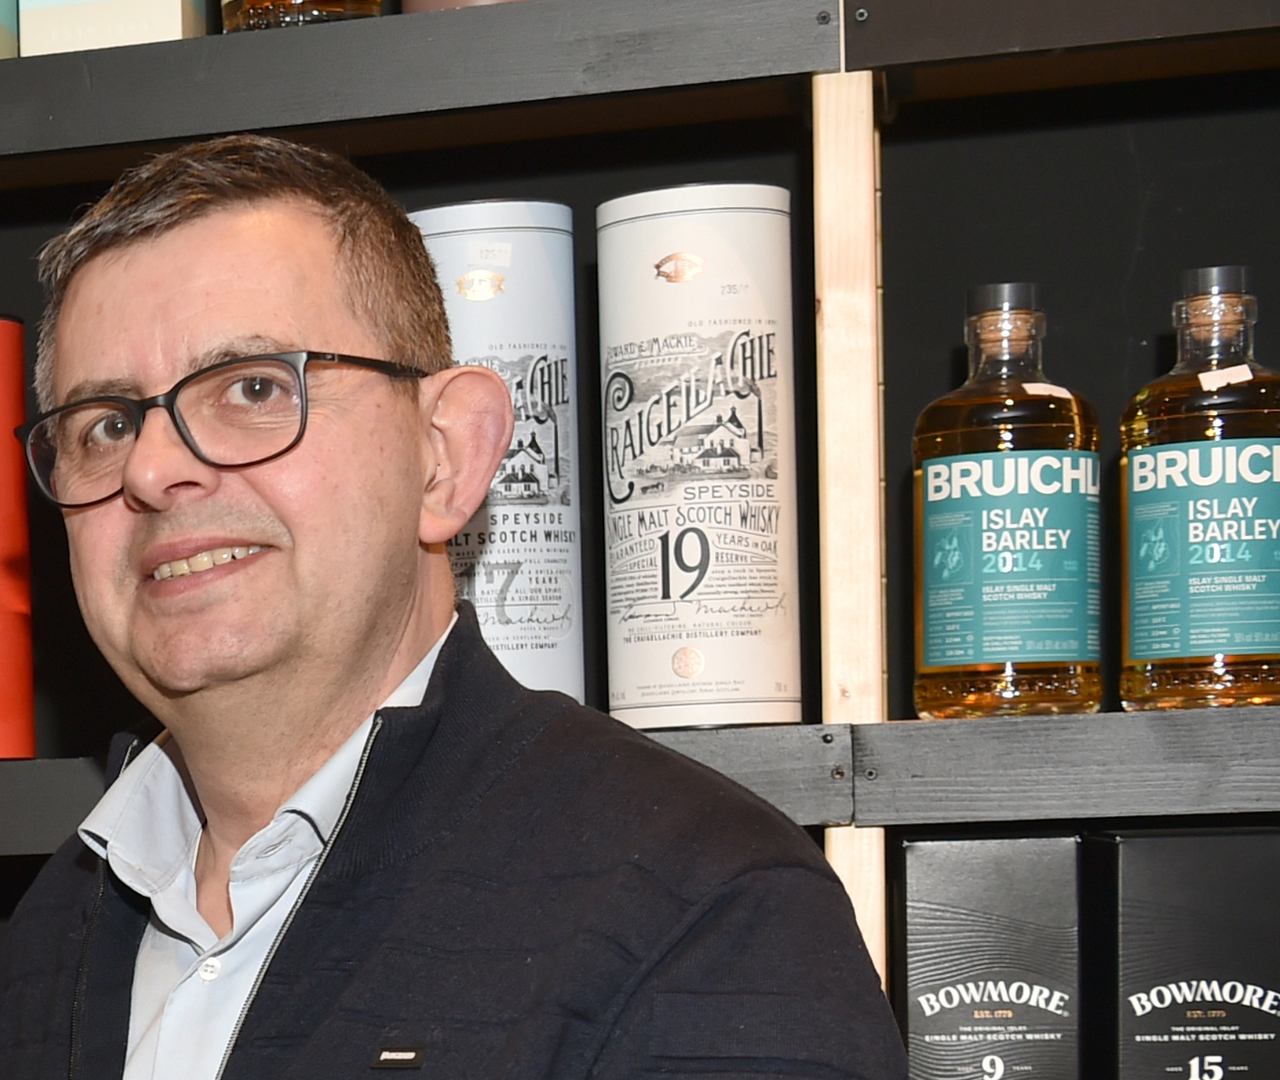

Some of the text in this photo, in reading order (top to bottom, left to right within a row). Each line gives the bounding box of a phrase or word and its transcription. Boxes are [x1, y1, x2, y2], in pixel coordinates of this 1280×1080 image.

[651, 335, 696, 354] MACKIE
[605, 328, 778, 505] CRAIGELLACHIE
[927, 455, 1100, 501] BRUICHL
[683, 484, 775, 501] SPEYSIDE
[490, 513, 563, 526] SPEYSIDE
[637, 500, 781, 538] MALT SCOTCH WHISKY
[982, 507, 1049, 530] ISLAY
[1189, 497, 1258, 520] ISLAY
[477, 531, 538, 545] SCOTCH
[982, 529, 1071, 552] BARLEY
[1189, 518, 1280, 543] BARLEY
[657, 527, 711, 600] 19
[716, 532, 750, 548] YEARS
[715, 551, 749, 564] RESERVE
[982, 551, 1043, 573] 2014
[1189, 542, 1253, 565] 2014
[982, 583, 1057, 593] ISLAY SINGLE MALT
[1189, 574, 1267, 586] ISLAY SINGLE MALT
[1189, 583, 1257, 593] SCOTCH WHISKY
[982, 591, 1048, 602] SCOTCH WHISKY
[917, 980, 1070, 1017] BOWMORE
[1127, 979, 1280, 1017] BOWMORE
[924, 1034, 957, 1042] SINGLE
[986, 1033, 1023, 1041] SCOTCH
[1025, 1032, 1062, 1040] WHISKY
[1134, 1034, 1169, 1042] SINGLE
[1198, 1033, 1236, 1041] SCOTCH
[1237, 1032, 1276, 1041] WHISKY
